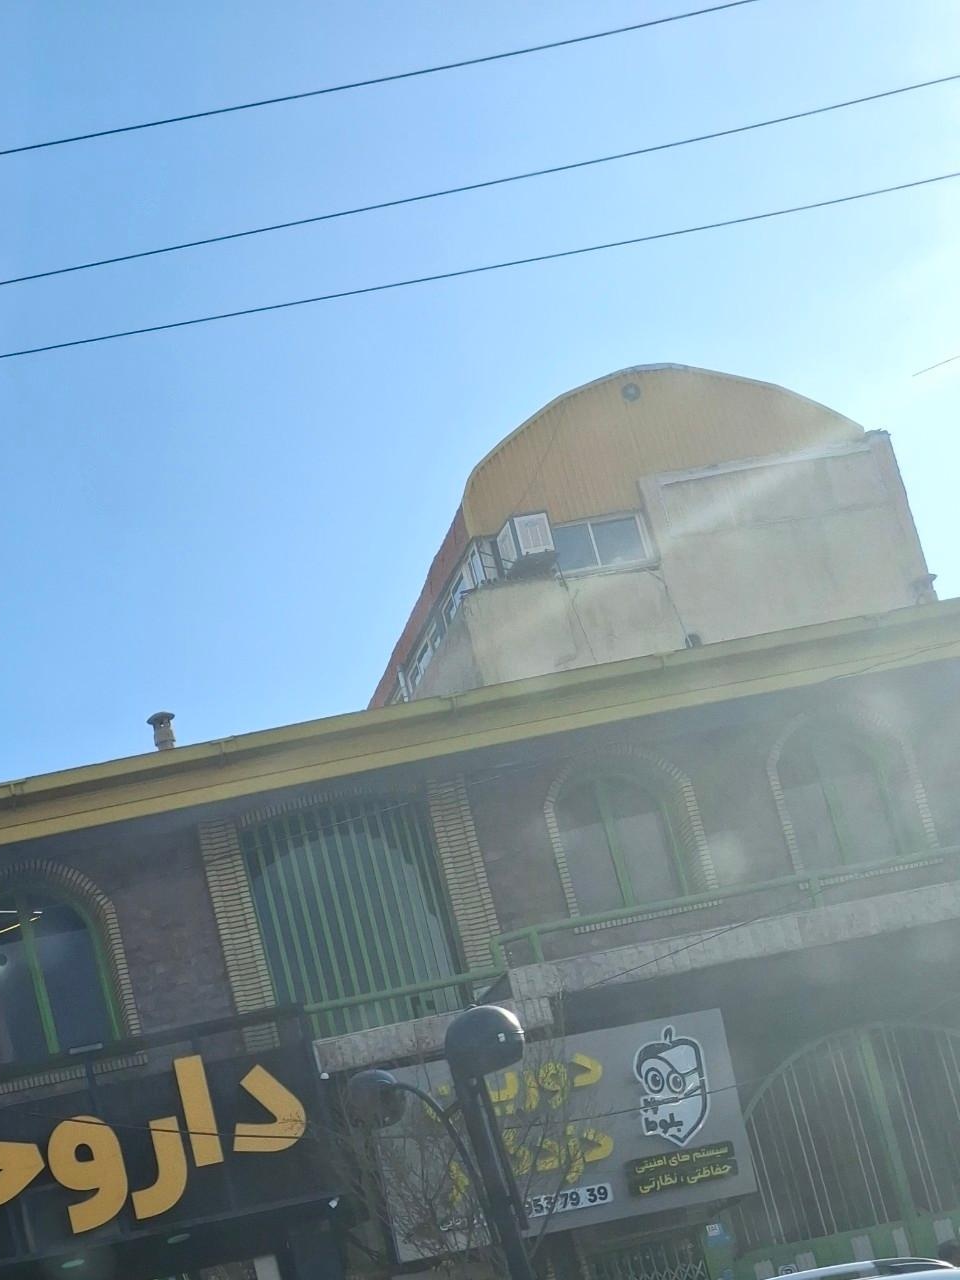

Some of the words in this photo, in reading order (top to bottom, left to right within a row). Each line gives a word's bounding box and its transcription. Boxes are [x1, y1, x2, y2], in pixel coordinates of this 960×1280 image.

[635, 1155, 667, 1174] امنیتی
[692, 1146, 729, 1162] سیستم
[639, 1172, 678, 1194] نظارتی
[686, 1163, 732, 1184] حفاظتی
[559, 1191, 581, 1209] 79
[586, 1185, 609, 1204] 39
